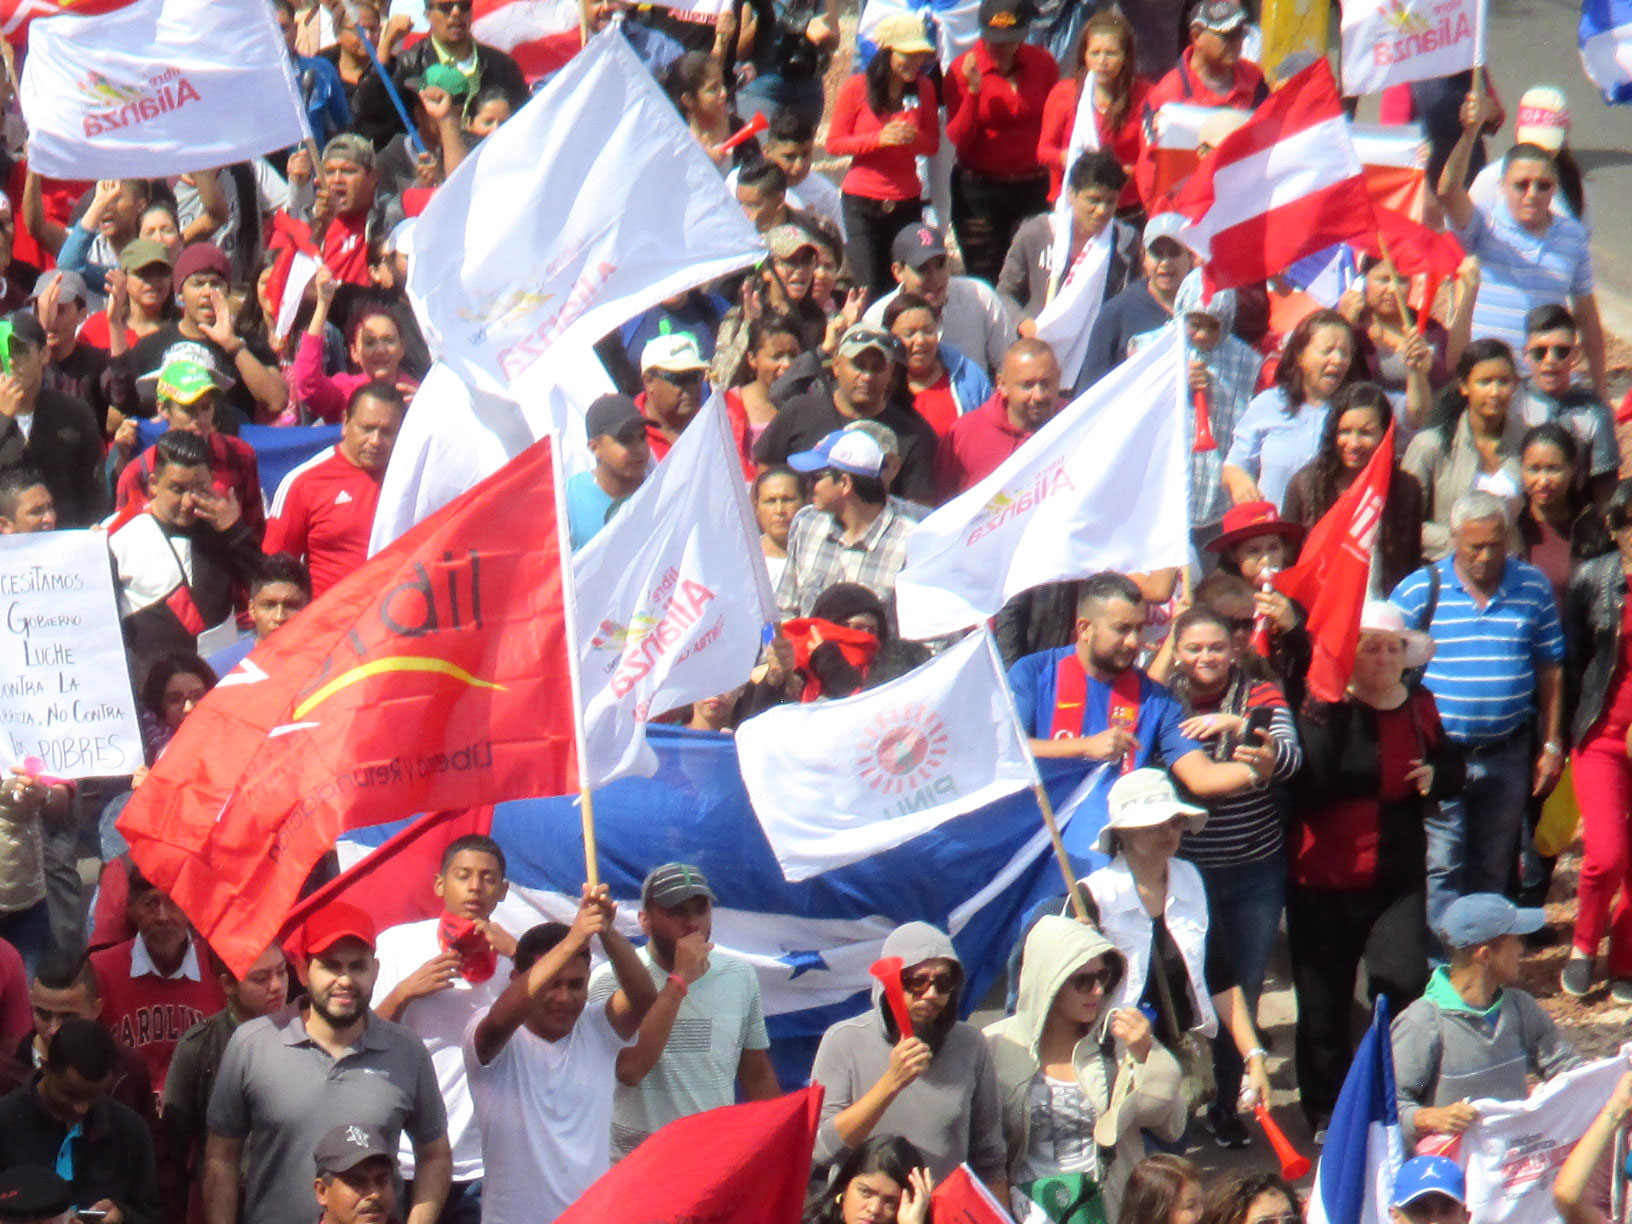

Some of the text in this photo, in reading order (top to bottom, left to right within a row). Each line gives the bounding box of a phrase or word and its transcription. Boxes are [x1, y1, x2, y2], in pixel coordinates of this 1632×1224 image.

[7, 601, 82, 637] GOBIERNO
[23, 640, 75, 667] LUCHE
[59, 671, 80, 693] LA
[73, 700, 125, 721] CONTRA
[38, 734, 126, 773] POBRES
